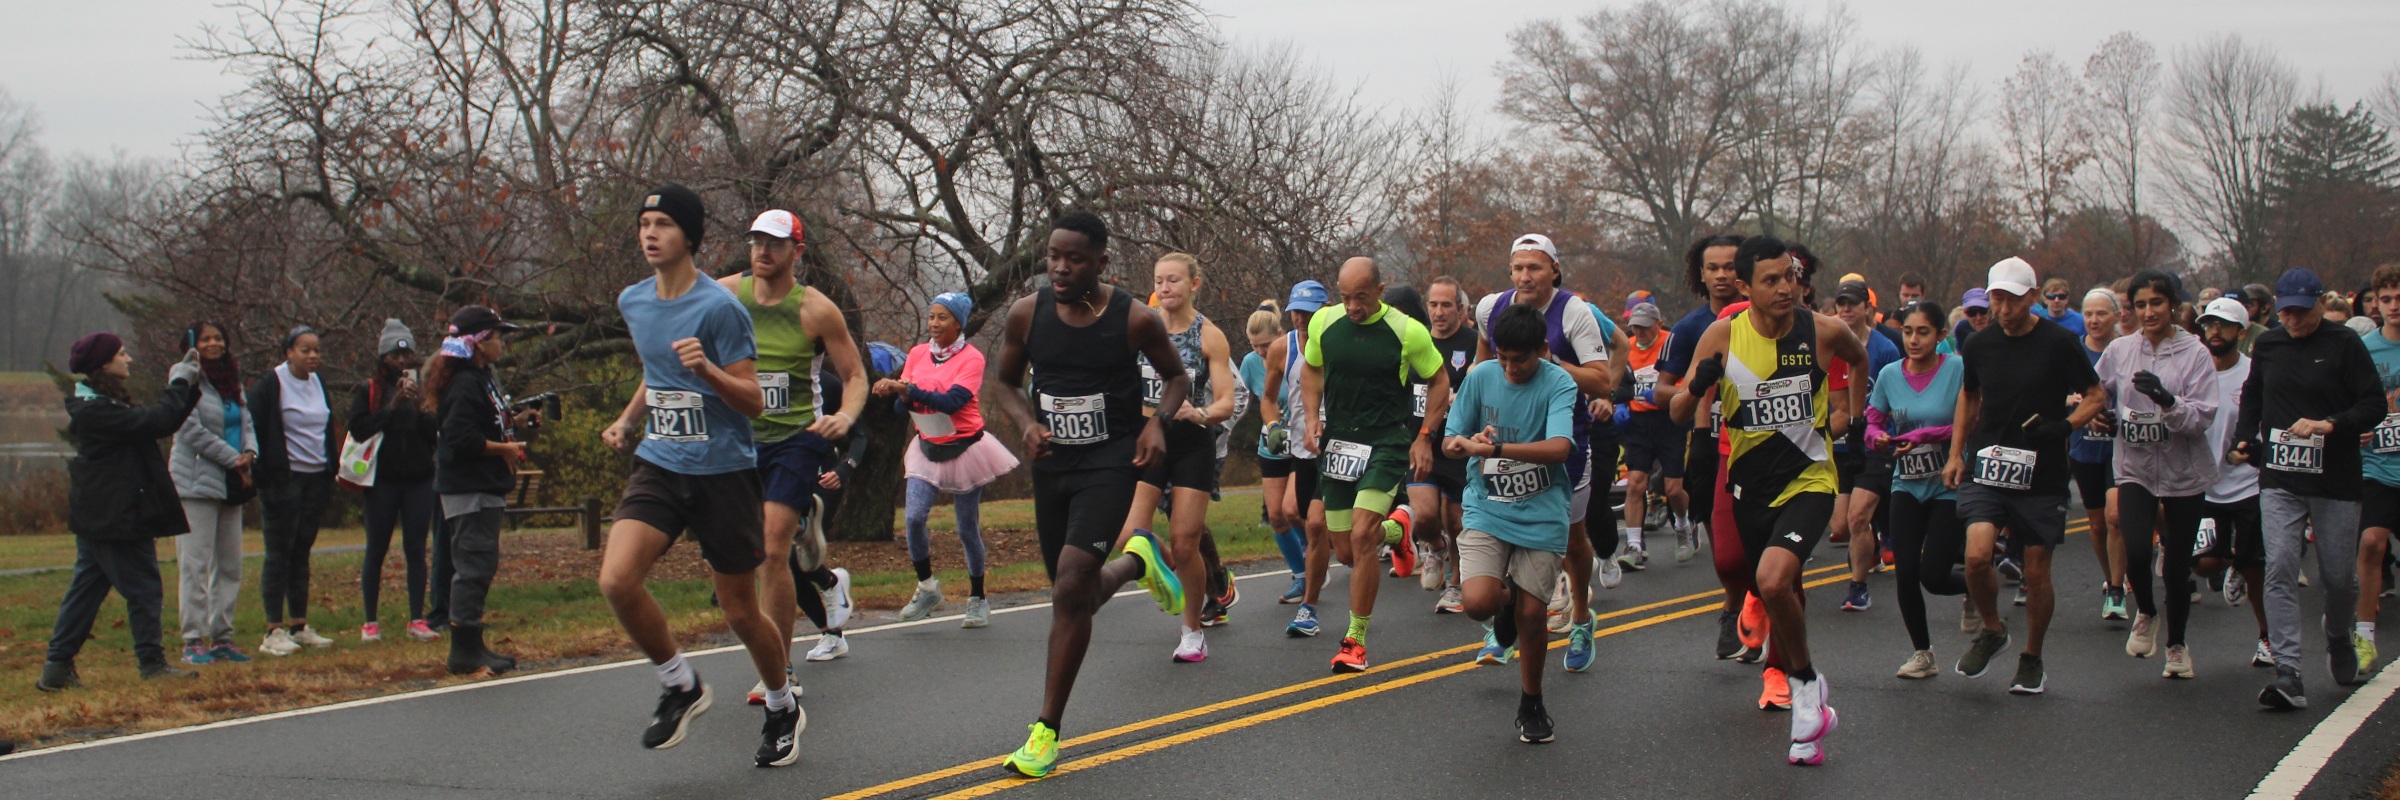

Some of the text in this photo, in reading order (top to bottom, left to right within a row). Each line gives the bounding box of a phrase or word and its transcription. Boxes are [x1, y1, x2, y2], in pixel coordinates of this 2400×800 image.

[1782, 354, 1811, 366] GSTC
[1146, 379, 1163, 399] 12
[1415, 395, 1427, 413] 13
[1746, 395, 1802, 425] 1388
[651, 407, 693, 436] 1321
[1046, 413, 1094, 439] 1303
[2124, 422, 2161, 442] 1340
[1325, 453, 1359, 476] 1307
[1901, 453, 1935, 474] 1341
[2271, 443, 2312, 468] 1344
[1980, 458, 2023, 484] 1372
[1490, 470, 1539, 497] 1289
